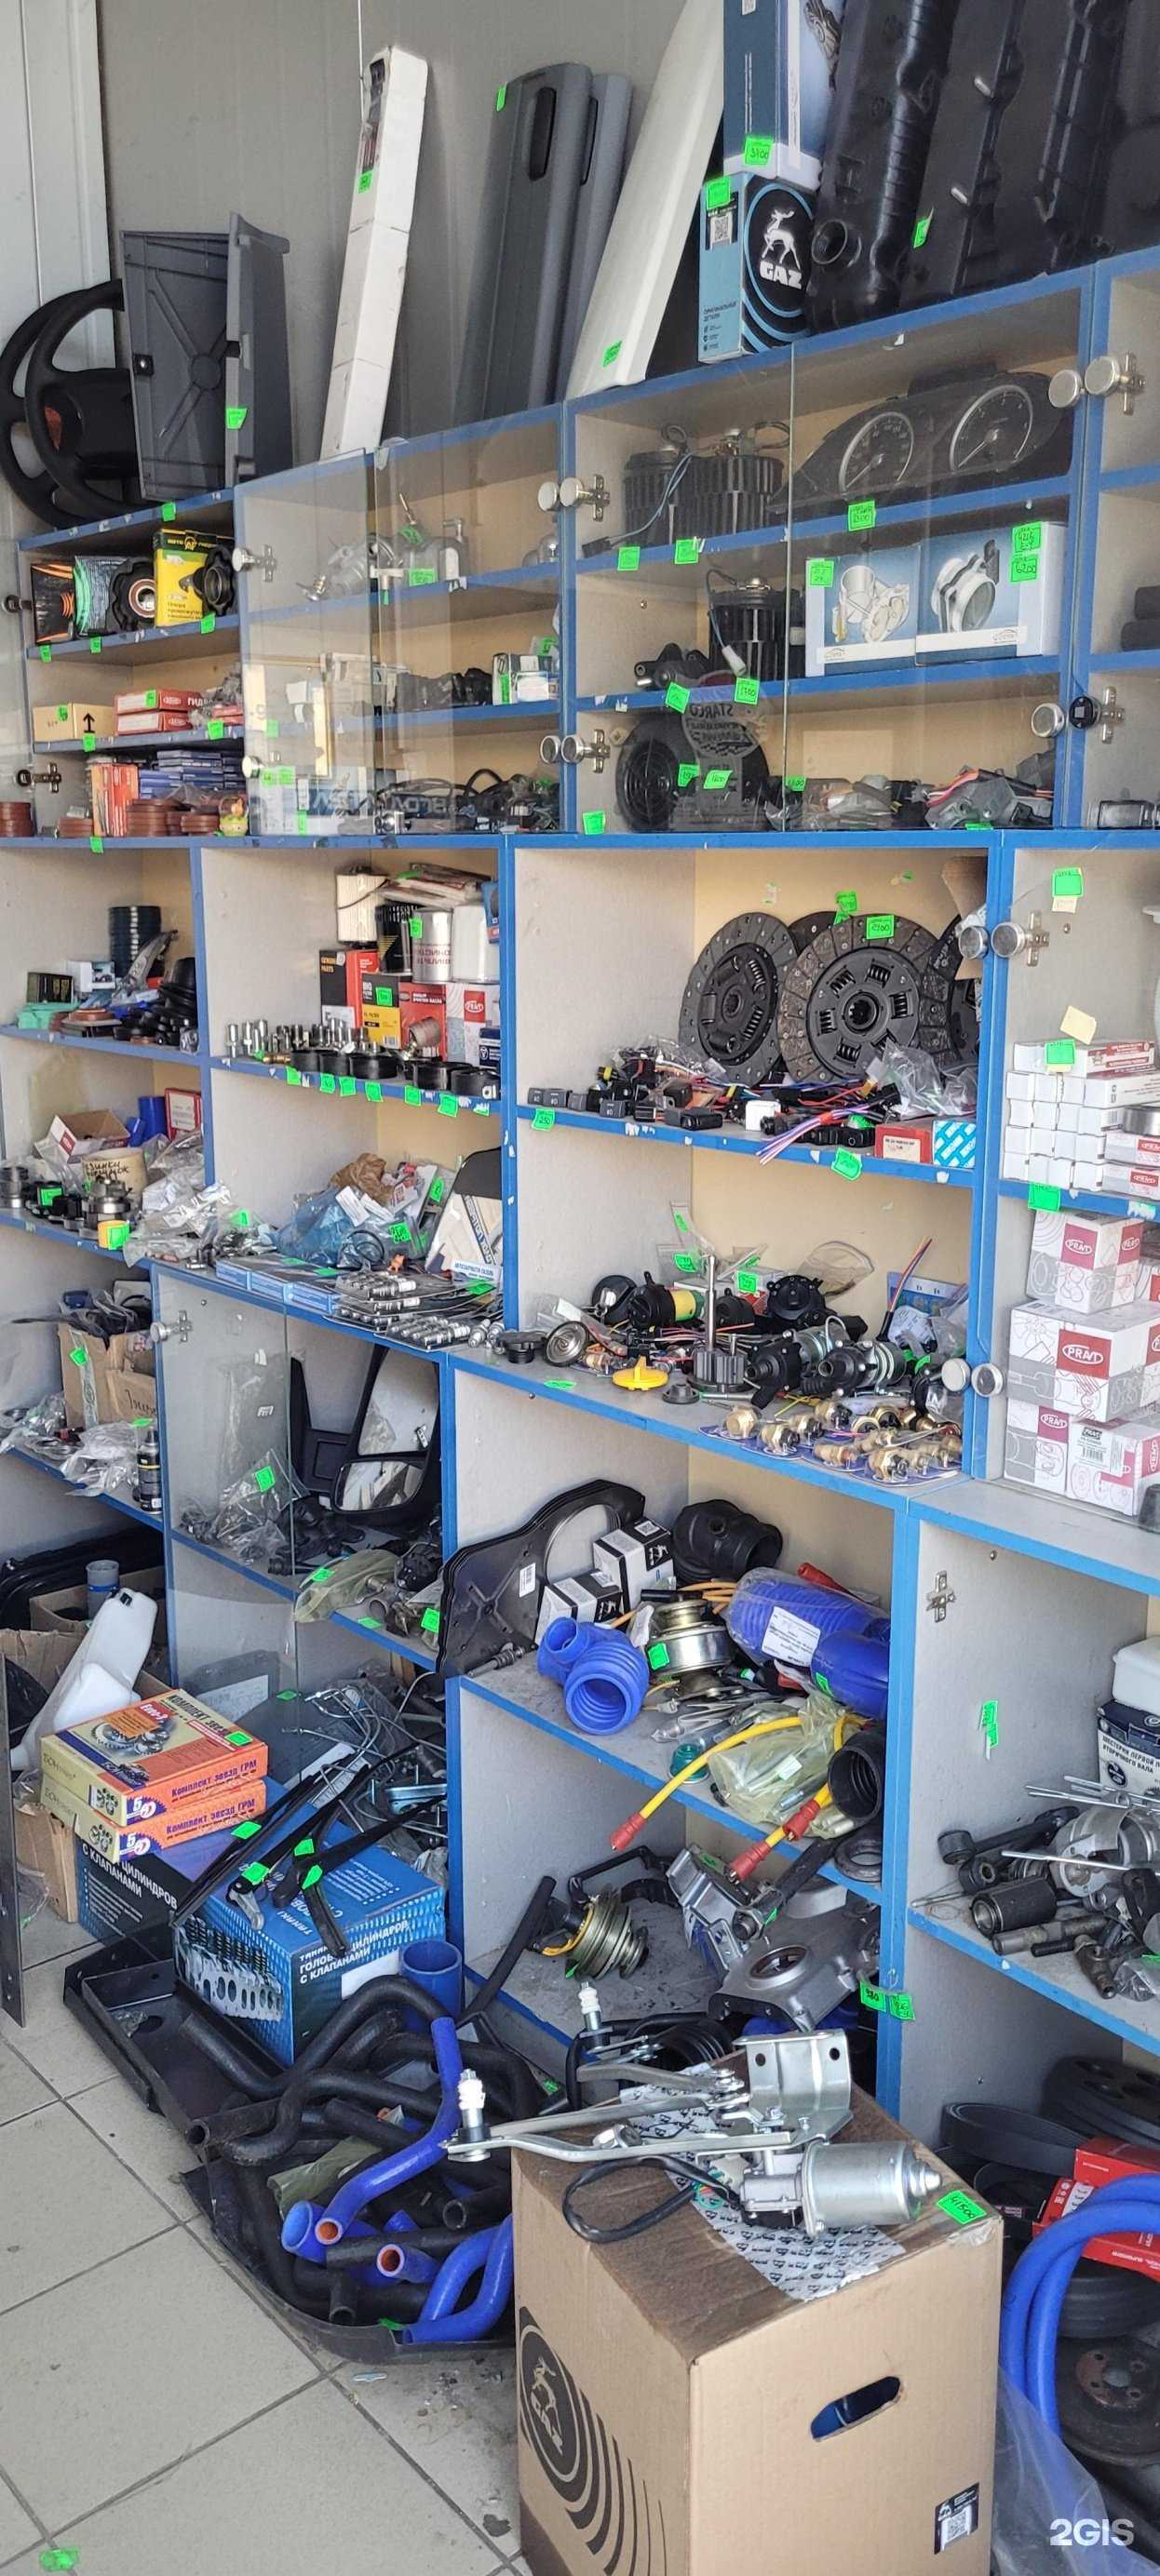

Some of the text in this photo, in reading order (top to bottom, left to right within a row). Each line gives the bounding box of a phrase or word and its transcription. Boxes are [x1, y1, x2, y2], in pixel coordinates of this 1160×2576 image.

[760, 261, 802, 289] GAZ
[1066, 1347, 1100, 1363] PRAVT
[240, 1759, 257, 1773] ГРМ
[1137, 1761, 1153, 1774] ВАЛА
[237, 1798, 255, 1813] ГРМ
[89, 1848, 142, 1898] КЛАПАНАМИ
[121, 1860, 178, 1911] ЦИЛИНДРОВ
[309, 1945, 371, 1980] КЛАПАНАМИ
